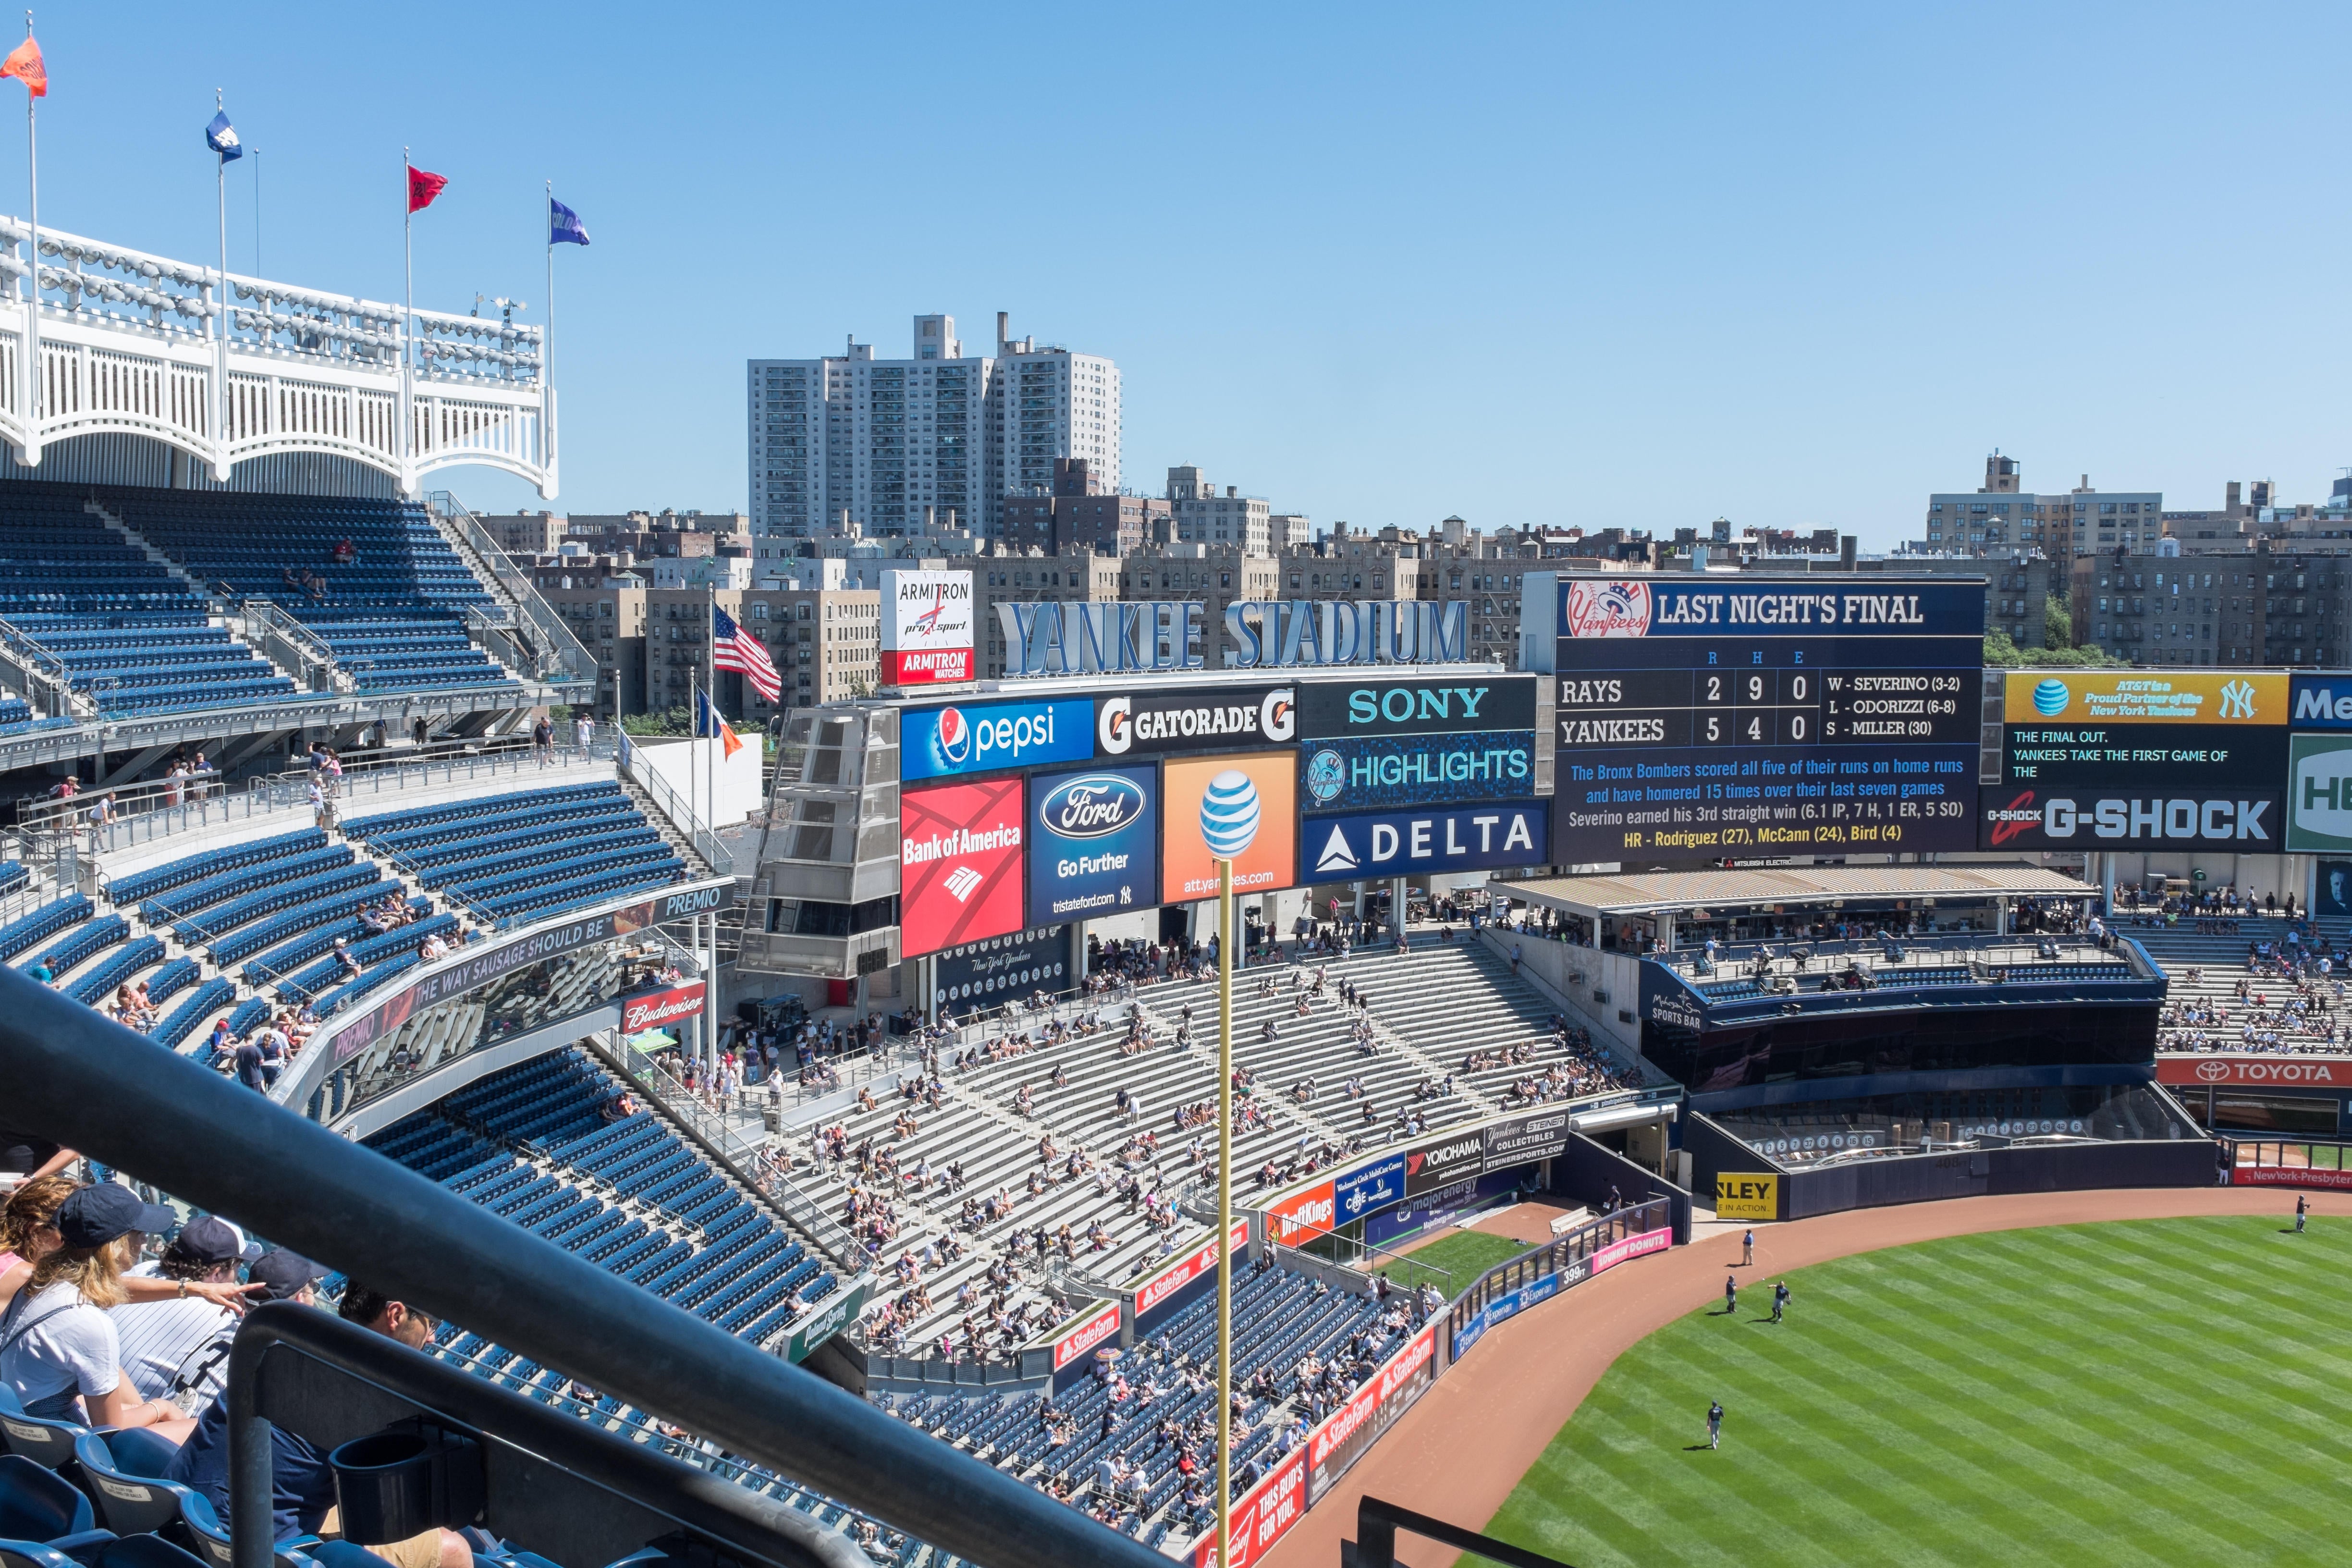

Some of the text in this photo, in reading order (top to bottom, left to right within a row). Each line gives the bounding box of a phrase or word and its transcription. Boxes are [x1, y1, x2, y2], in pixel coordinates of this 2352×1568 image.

[900, 584, 968, 600] ARMITRON
[1568, 590, 1923, 637] Yankees LAST NIGHT'S FINAL
[905, 621, 966, 636] pro sport
[994, 600, 1470, 676] YANKEE STADIUM
[904, 652, 967, 671] ARMITRON
[1708, 651, 1803, 664] R H E
[935, 668, 965, 678] WATCHES
[1827, 677, 1960, 692] W SEVERINO (3-2)
[1562, 676, 1806, 702] RAYS 2 9 0
[2116, 681, 2152, 691] AT&T
[1349, 687, 1488, 723] SONY
[1830, 700, 1955, 714] L ODORIZZI (6-8)
[2084, 694, 2169, 703] Proud Partner
[2090, 706, 2117, 715] New
[2119, 706, 2146, 715] York
[976, 706, 1053, 761] pepsi
[1136, 706, 1257, 740] GATORADE
[1561, 716, 1805, 743] YANKEES 5 4 0
[1826, 721, 1932, 735] S MILLER (30)
[2015, 732, 2108, 742] THE FINAL OUT.
[2014, 750, 2228, 761] YANKEES TAKE THE FIRST GAME OF
[1352, 749, 1528, 787] HIGHLIGHTS
[1571, 759, 1963, 781] The Bronx Bombers scored all five of their runs on home runs
[2014, 767, 2036, 777] THE
[1586, 782, 1945, 803] and have homered 15 times over their last seven games
[1061, 785, 1126, 828] Ford
[1569, 802, 1963, 827] Severino earned his 3rd straight win (6.1 IP, 7 H, 1 ER, 5 SO)
[1988, 799, 2271, 839] G-SHOCK G-SHOCK
[903, 824, 1020, 865] Bank of America
[1372, 815, 1533, 861] DELTA
[1625, 825, 1901, 848] HR Rodriguez (27), McCann (24), Bird (4)
[1058, 853, 1128, 878] Go Further
[666, 887, 720, 916] PREMIO
[1053, 894, 1114, 913] tristateford.com
[416, 979, 439, 1005] THE
[442, 966, 470, 992] WAY
[473, 944, 525, 980] SAUSAGE
[528, 927, 582, 956] SHOULD
[972, 950, 1030, 974] New York Yankees
[627, 997, 703, 1029] Budweiser
[1653, 994, 1683, 1011] Mohegan
[1653, 1008, 1700, 1029] SPORTS BAR
[335, 1012, 374, 1061] PREMIO
[2235, 1064, 2332, 1080] TOYOTA
[1602, 1094, 1642, 1107] pinstripebowl.com
[1487, 1117, 1564, 1147] Yankees STEINER
[1497, 1131, 1554, 1151] COLLECTIBLES
[1425, 1138, 1481, 1166] YOKOHAMA
[1486, 1144, 1565, 1169] STEINERSPORTS.COM
[1337, 1162, 1402, 1191] Workmen's Circle MultiCare Center
[1438, 1162, 1481, 1180] yokohamatire.com
[1282, 1198, 1332, 1237] DraftKings
[1423, 1212, 1455, 1229] MajorEnergy.com
[1629, 1235, 1665, 1252] DONUTS
[1530, 1284, 1552, 1301] Experian
[804, 1312, 827, 1347] Poland
[826, 1301, 848, 1331] Spring
[1489, 1304, 1512, 1321] Experian
[1260, 1461, 1303, 1519] THIS BUD'S
[1260, 1495, 1295, 1546] FOR YOU.
